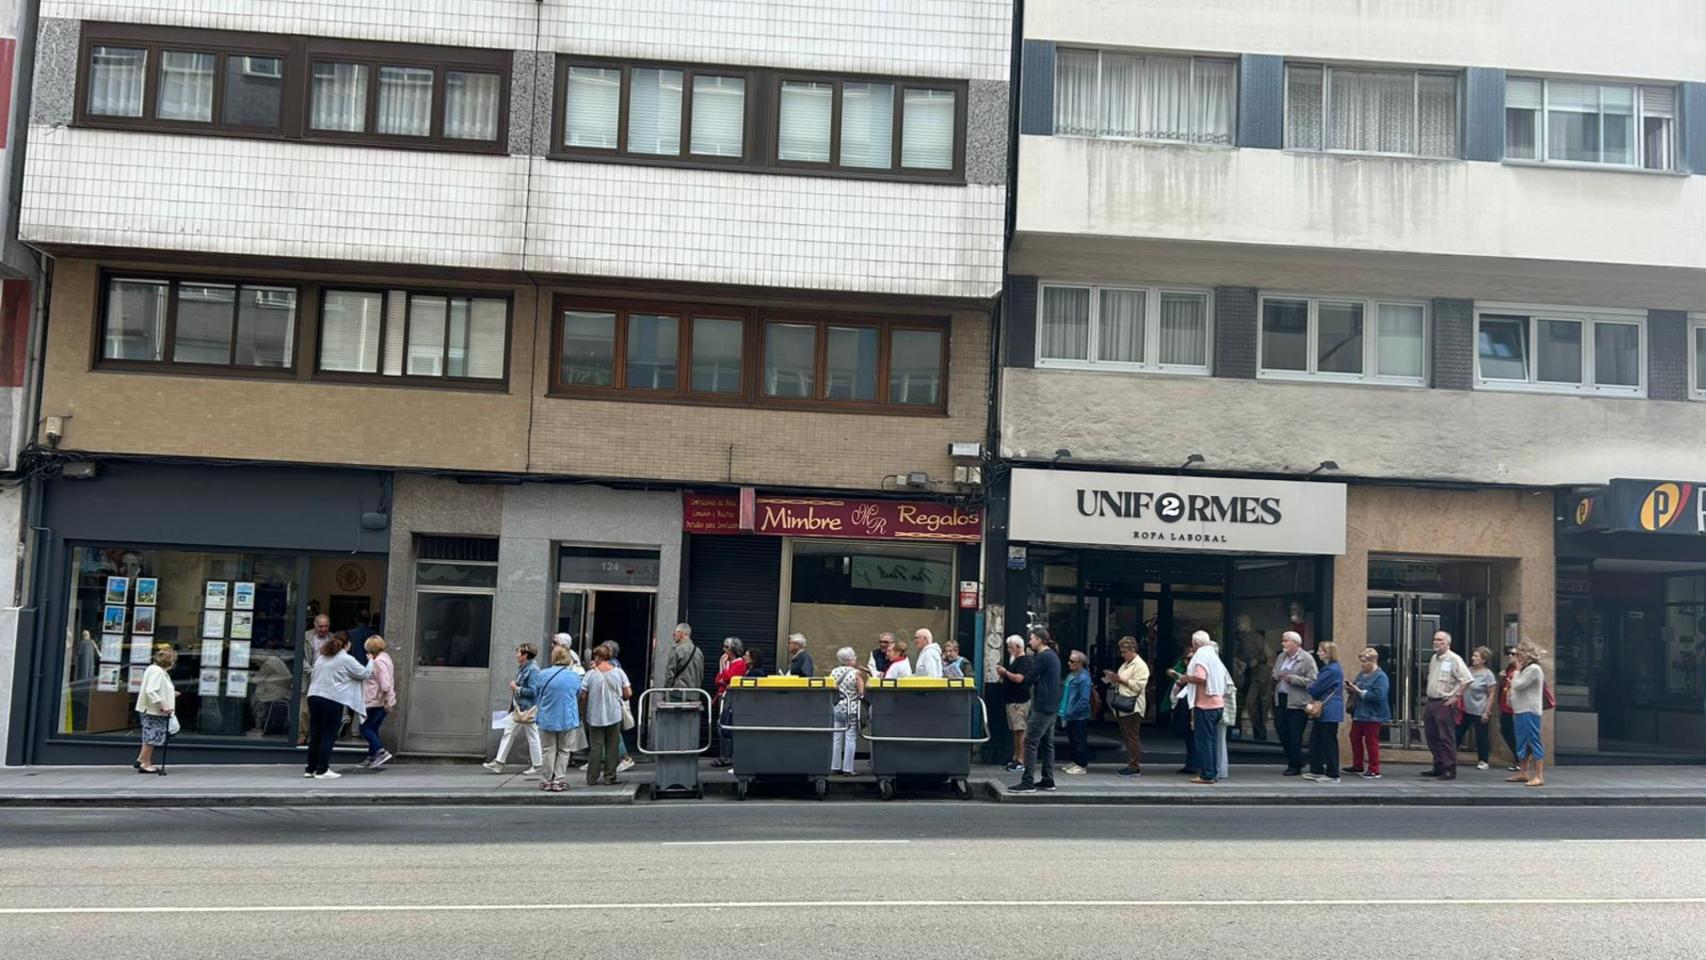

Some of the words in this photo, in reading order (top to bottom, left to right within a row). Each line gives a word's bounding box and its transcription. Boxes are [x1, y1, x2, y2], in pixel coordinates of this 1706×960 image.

[761, 507, 843, 531] Mimbre
[898, 505, 979, 531] Regalos
[1133, 531, 1165, 541] ROPA
[1171, 532, 1227, 543] LABORAL
[601, 562, 619, 571] 124
